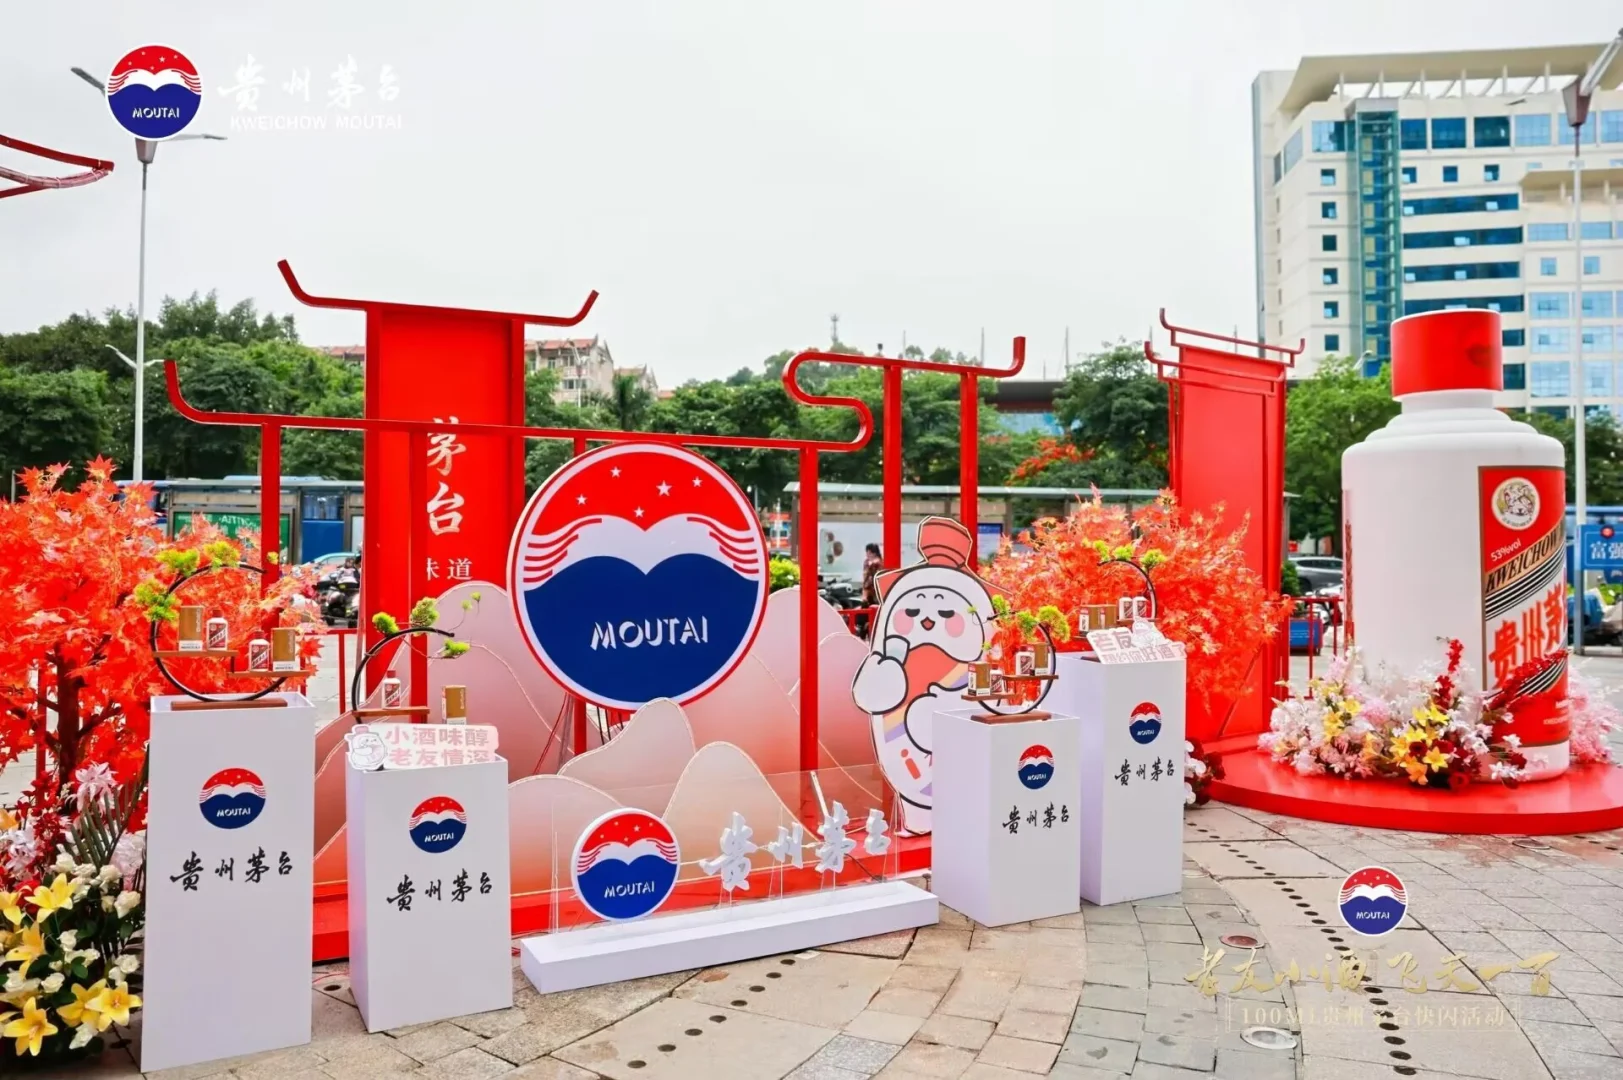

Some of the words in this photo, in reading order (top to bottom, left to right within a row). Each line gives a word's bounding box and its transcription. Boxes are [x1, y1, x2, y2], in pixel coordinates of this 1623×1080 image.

[1490, 538, 1522, 562] 53%vol
[589, 615, 708, 651] MOUTAI
[1489, 581, 1567, 690] 贵州茅
[385, 726, 489, 747] 小酒味醇
[388, 747, 490, 767] 老友情深
[1114, 756, 1175, 786] 贵州茅台
[216, 807, 251, 818] MOUTAI
[1002, 801, 1070, 834] 贵州茅台
[424, 832, 455, 843] MOUTAI
[169, 846, 293, 892] 贵州茅台
[386, 868, 493, 912] 贵州茅台
[603, 881, 656, 900] MOUTAI
